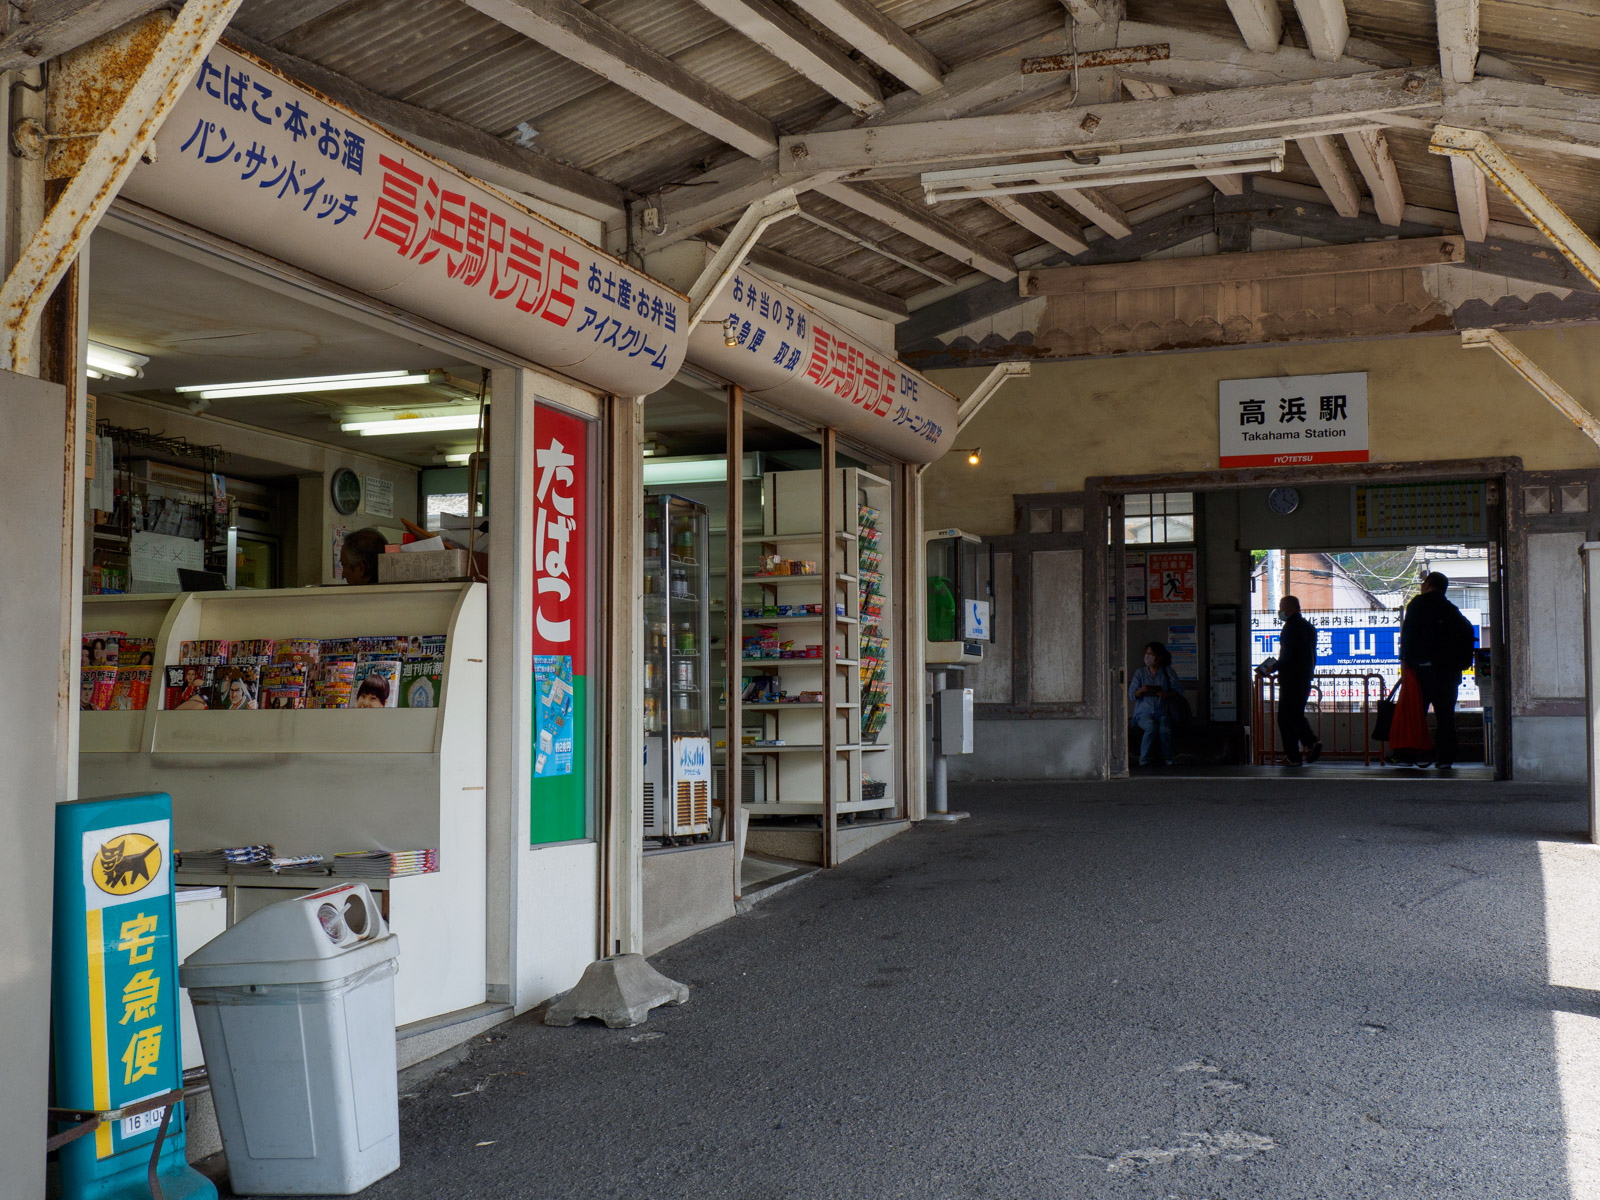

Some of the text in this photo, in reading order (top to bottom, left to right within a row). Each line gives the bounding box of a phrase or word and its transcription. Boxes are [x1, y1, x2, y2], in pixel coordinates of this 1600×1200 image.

[195, 54, 366, 176] たばこ・本・お酒
[180, 118, 359, 226] パン・サンドイッチ
[363, 153, 580, 328] 高浜駅売店
[587, 261, 677, 334] お土産・お弁当
[732, 275, 807, 340] お弁当の予約
[576, 306, 667, 371] アイスクリーム
[800, 325, 896, 418] 高浜駅売店
[900, 373, 918, 402] DPE
[1238, 394, 1348, 426] 高浜駅
[1241, 428, 1346, 441] Takahama Station
[535, 437, 577, 643] たばこ
[680, 745, 705, 767] Asahi
[117, 911, 163, 1086] 宅急便
